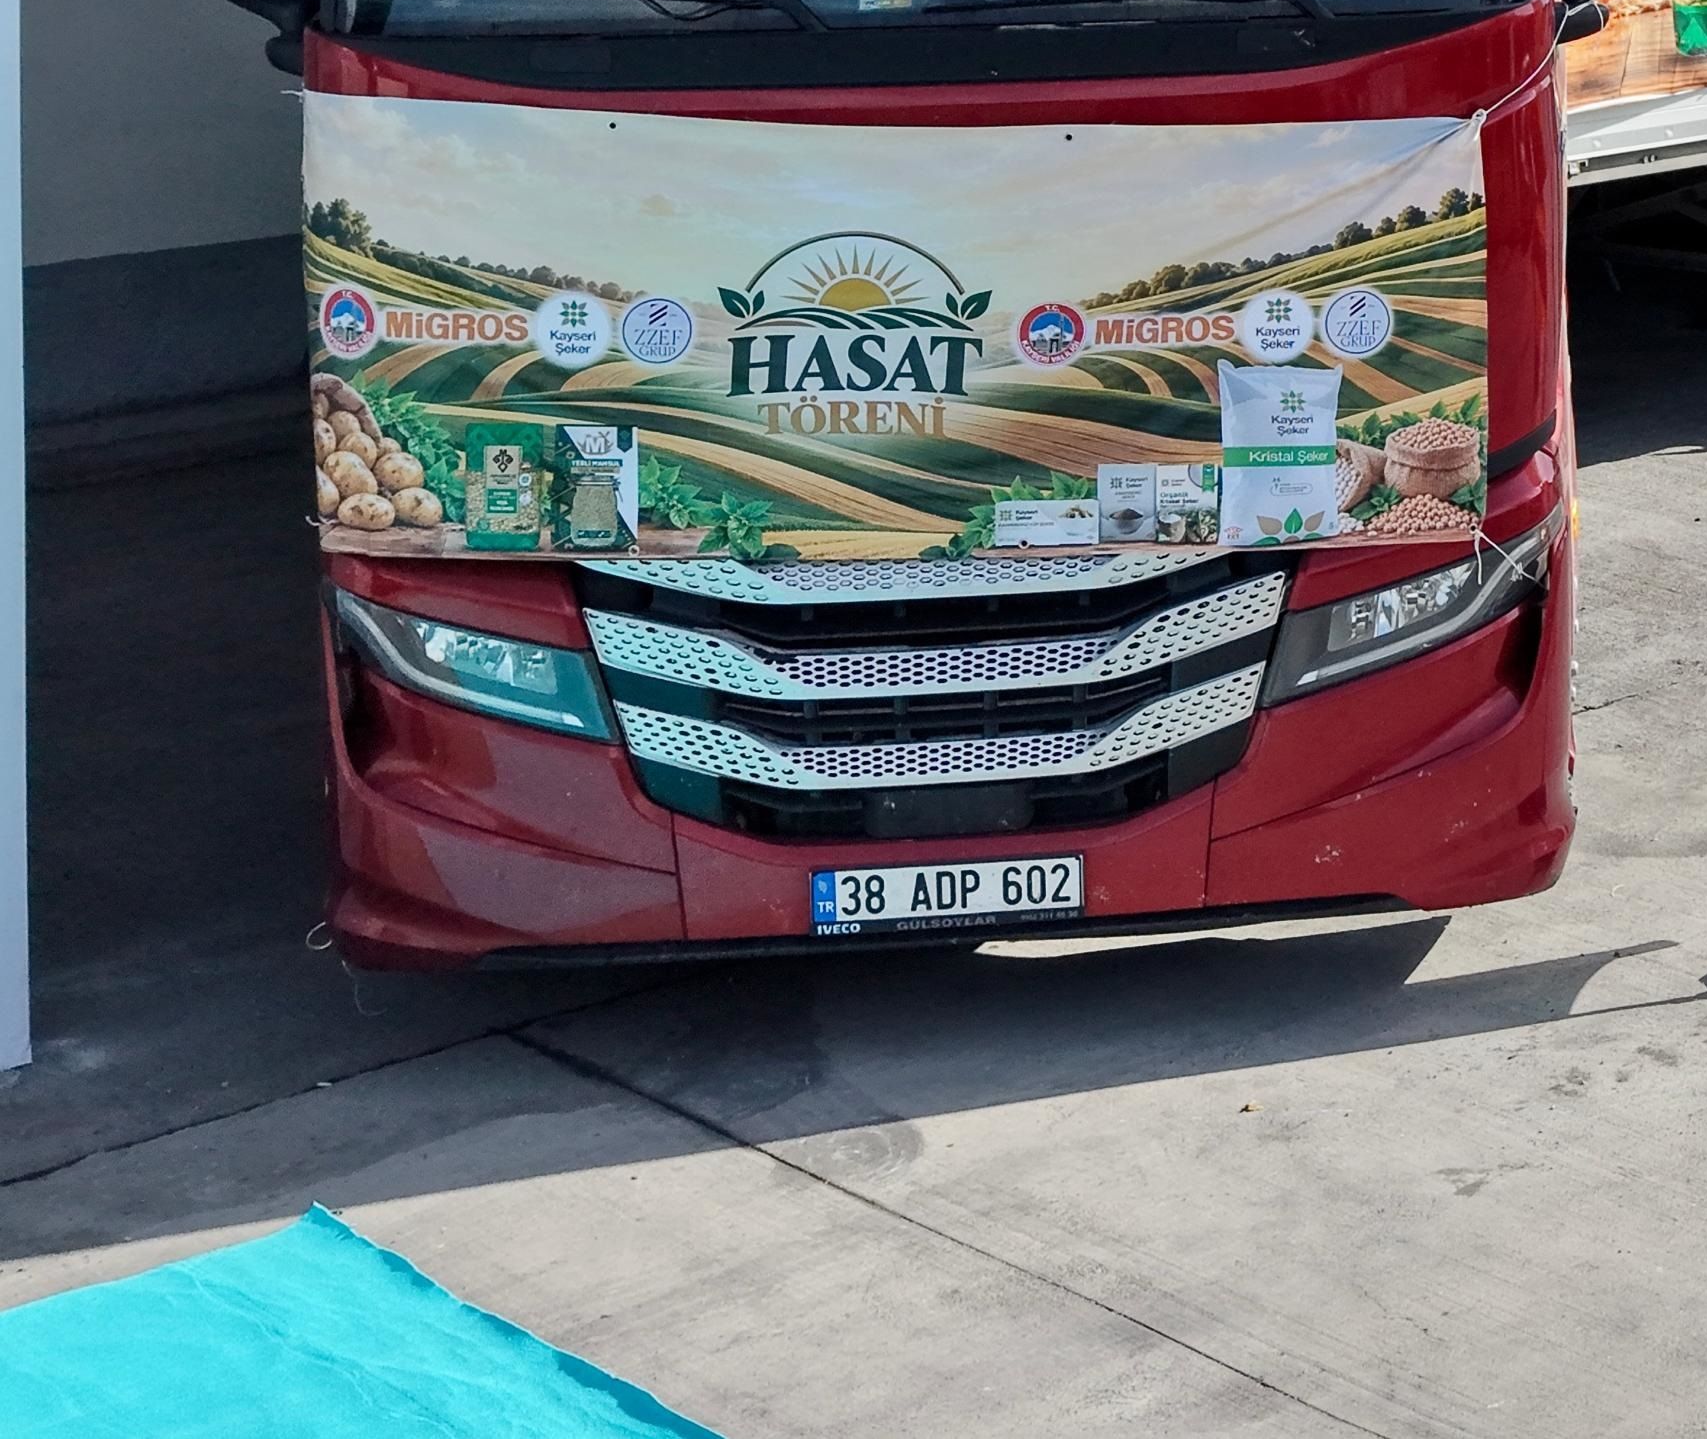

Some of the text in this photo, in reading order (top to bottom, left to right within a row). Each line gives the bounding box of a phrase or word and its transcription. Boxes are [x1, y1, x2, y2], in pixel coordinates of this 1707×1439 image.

[1255, 326, 1301, 341] Kayseri
[1336, 320, 1383, 338] ZZEF
[549, 329, 597, 345] Kayseri
[633, 328, 683, 346] ZZEF
[1339, 336, 1377, 349] GRUP
[554, 342, 591, 356] Şeker
[638, 345, 677, 357] GRUP
[1260, 338, 1295, 352] Şeker
[726, 334, 983, 397] HASAT
[757, 395, 949, 439] TÖRENİ
[1270, 414, 1314, 427] Kayseri
[1277, 424, 1310, 436] Şeker
[1249, 449, 1329, 465] Kristal Şeker
[841, 863, 1071, 916] 38 ADP 602
[817, 900, 835, 914] TR
[817, 922, 861, 935] IVECO
